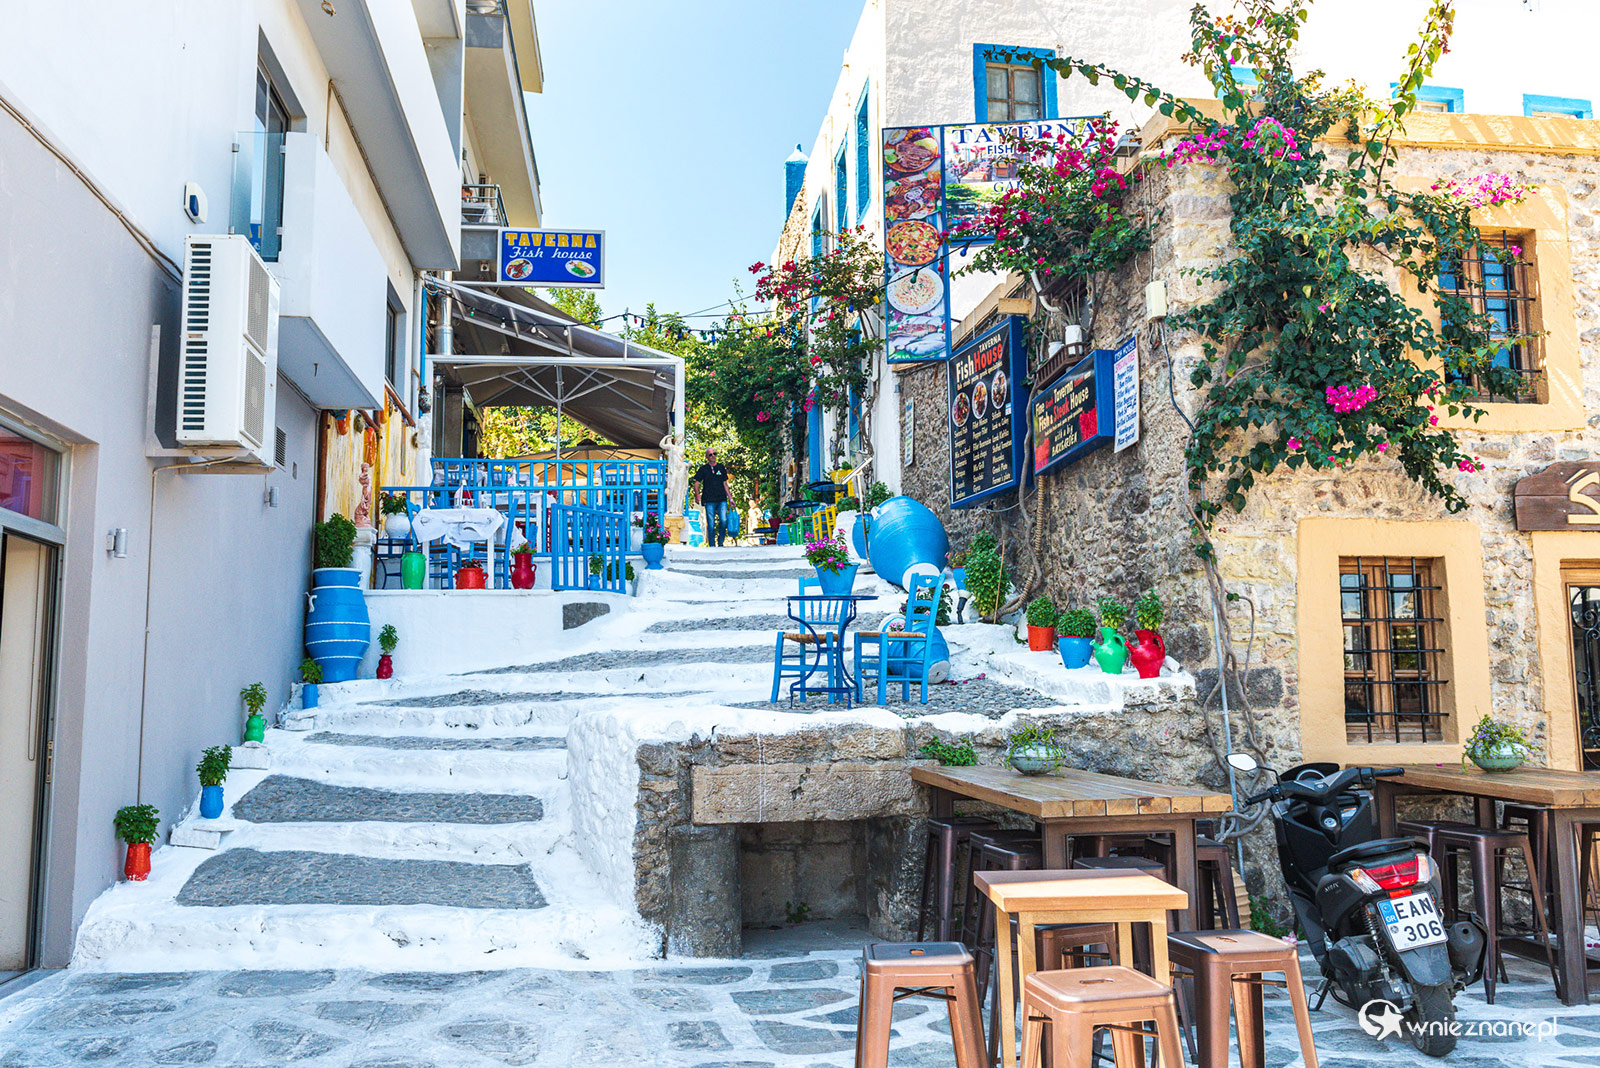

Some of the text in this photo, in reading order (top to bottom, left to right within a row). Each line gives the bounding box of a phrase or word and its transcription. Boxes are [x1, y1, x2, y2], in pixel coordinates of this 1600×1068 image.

[952, 121, 1099, 144] TAVERNA
[987, 144, 1013, 155] FISH
[505, 232, 597, 249] TAVERNA
[509, 246, 593, 260] Fish house
[978, 333, 1002, 353] TAVERNA
[1035, 402, 1045, 418] Fine
[1053, 379, 1074, 404] Taverna
[1038, 411, 1050, 433] Fish
[1053, 396, 1070, 423] Steak
[1070, 386, 1090, 411] House
[1385, 914, 1397, 923] GR
[1393, 897, 1434, 920] EAN
[1403, 920, 1442, 942] 306
